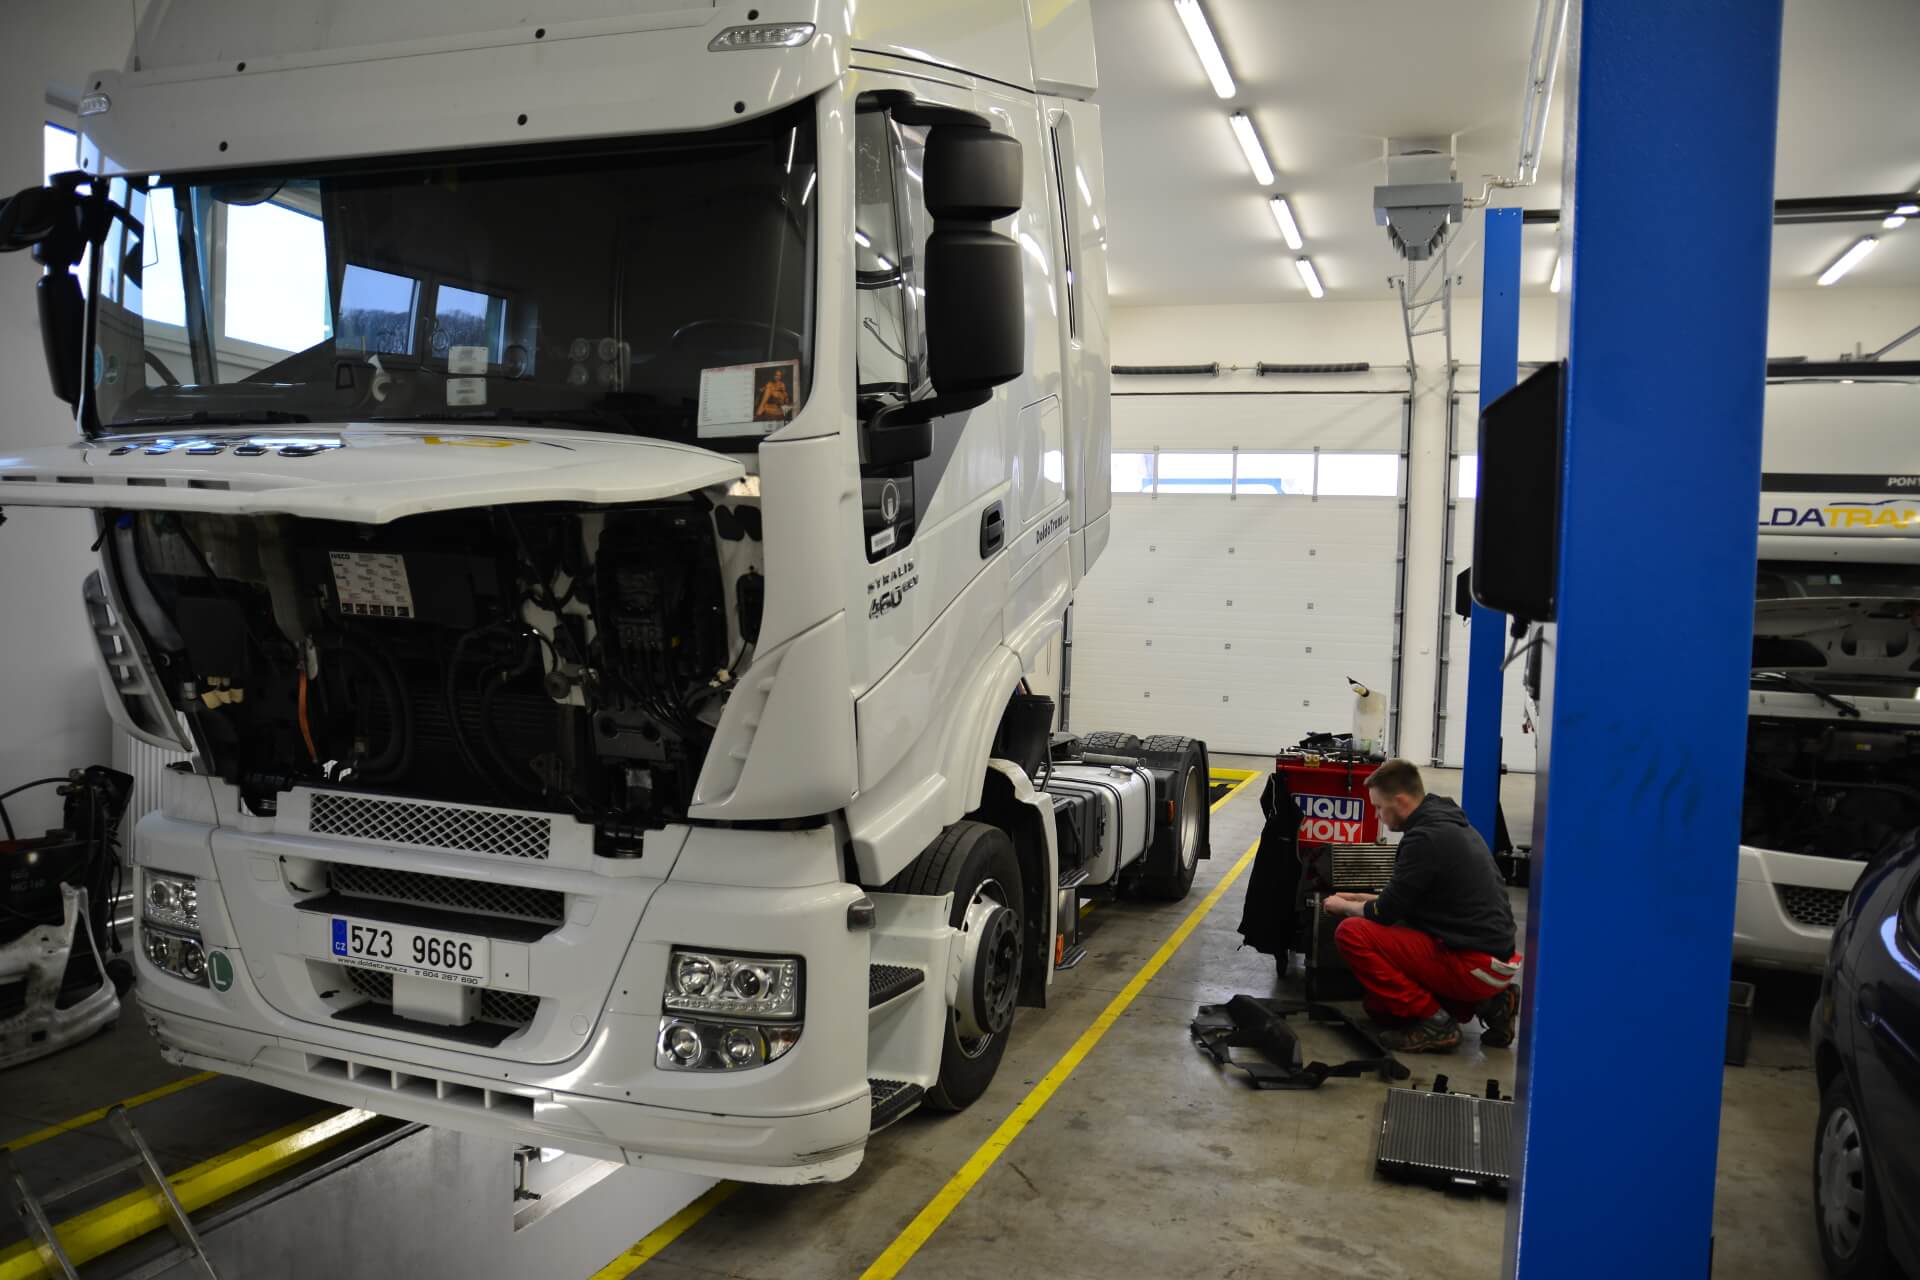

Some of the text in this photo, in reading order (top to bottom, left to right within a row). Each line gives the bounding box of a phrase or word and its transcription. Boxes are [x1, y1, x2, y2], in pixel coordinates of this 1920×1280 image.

[867, 562, 914, 594] STRALIS
[335, 941, 347, 951] CZ
[351, 925, 473, 971] 5Z3 9666
[212, 957, 227, 986] L
[423, 970, 439, 978] 604
